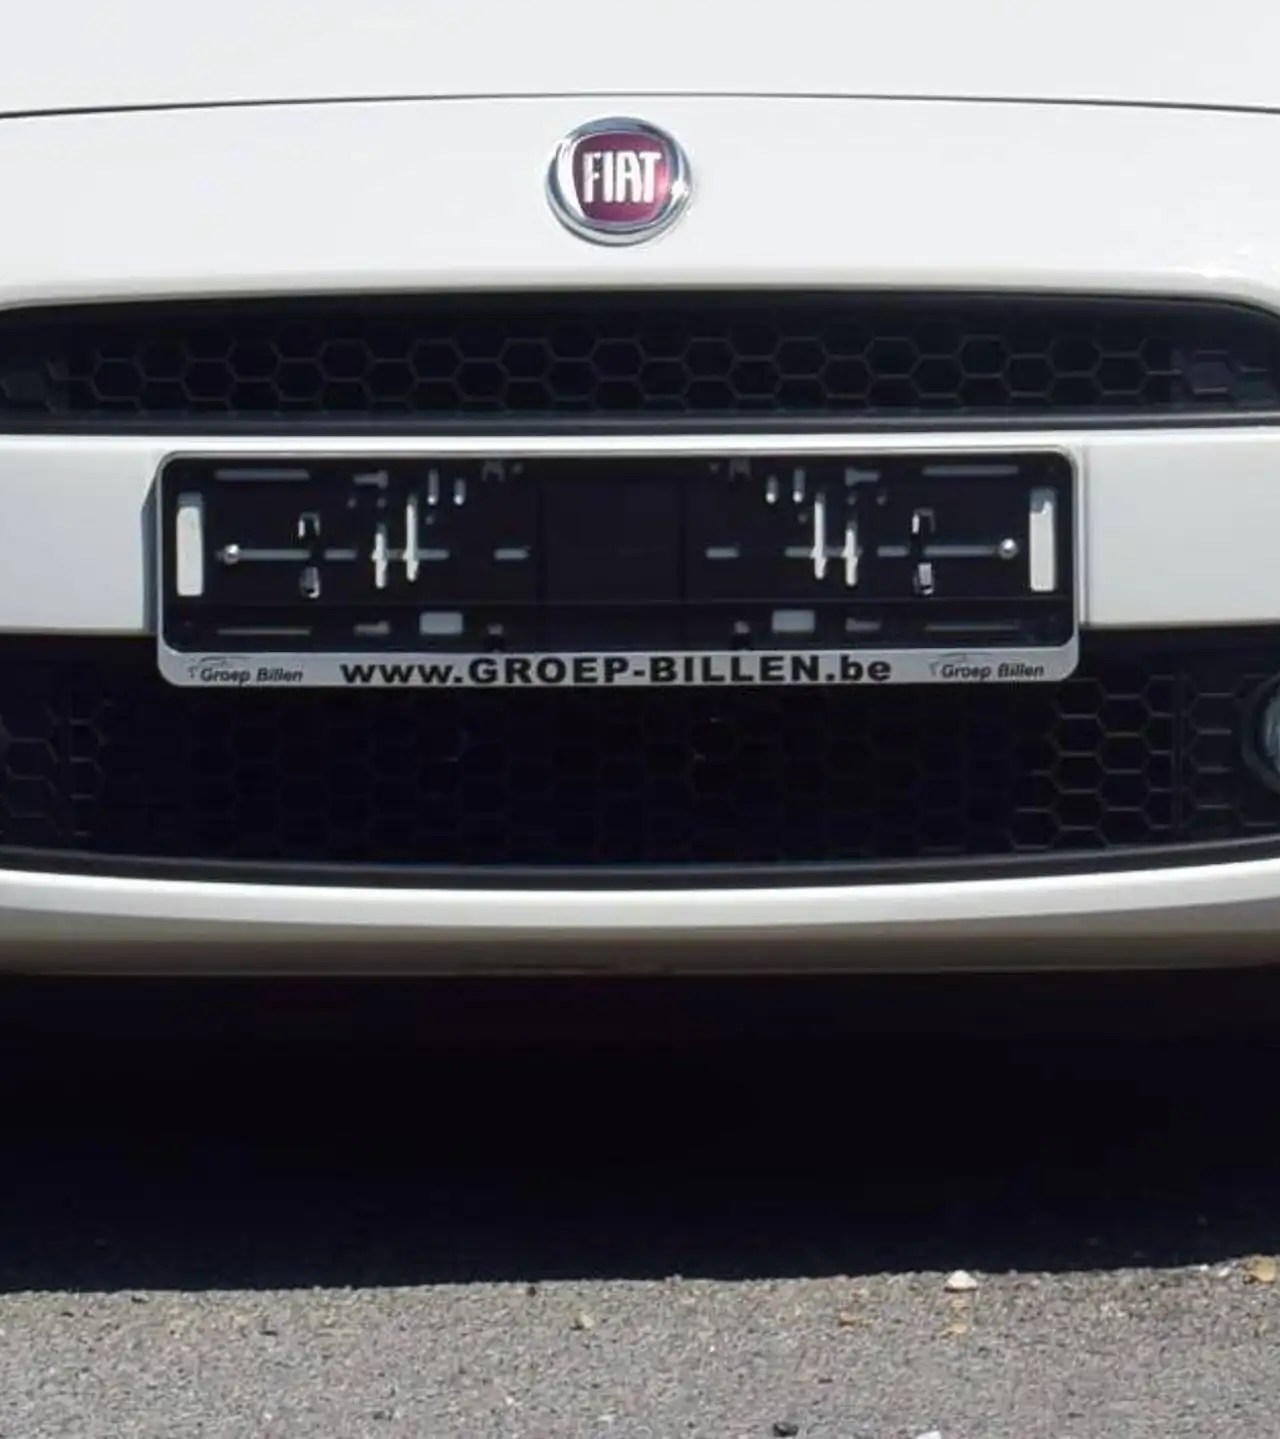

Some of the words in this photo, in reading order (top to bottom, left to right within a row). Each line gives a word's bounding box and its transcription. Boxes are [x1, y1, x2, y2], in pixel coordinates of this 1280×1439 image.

[582, 150, 663, 203] FIAT
[199, 667, 251, 685] Groep
[255, 667, 304, 683] Billen
[339, 653, 892, 685] www.GROEP-BILLEN.be
[939, 663, 993, 682] Groep
[996, 662, 1045, 679] Billen
